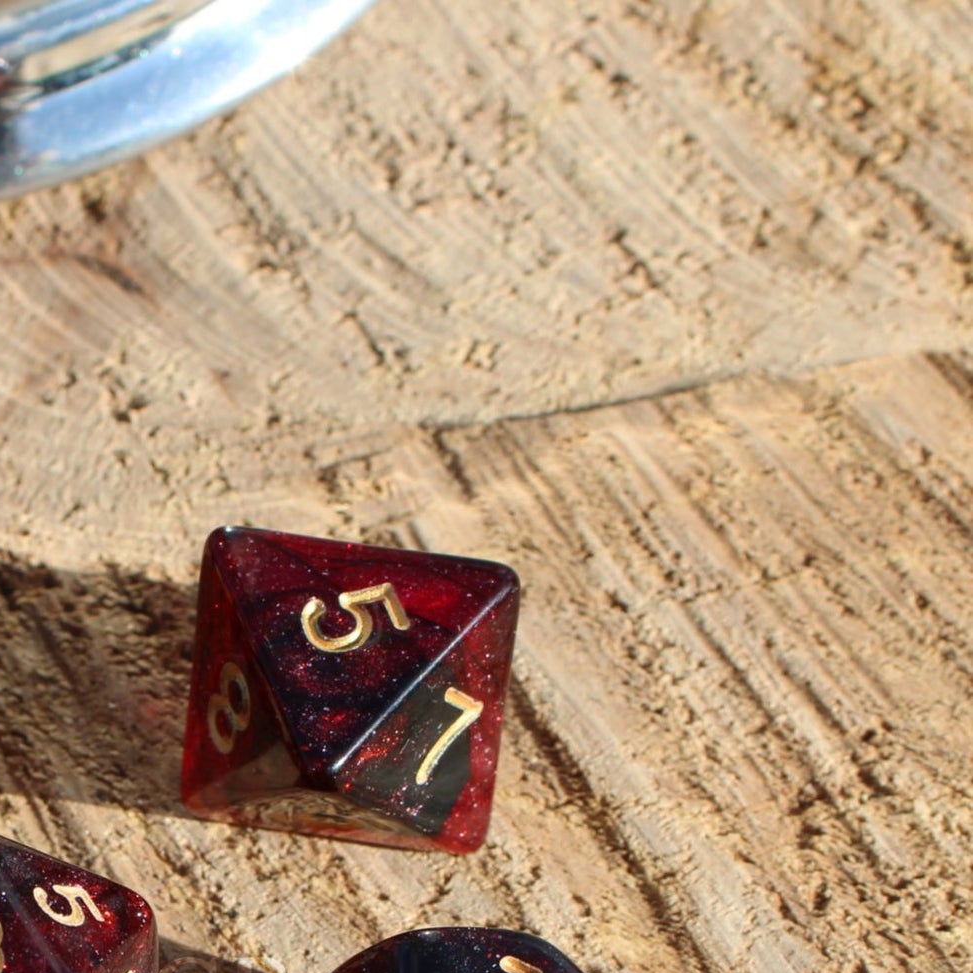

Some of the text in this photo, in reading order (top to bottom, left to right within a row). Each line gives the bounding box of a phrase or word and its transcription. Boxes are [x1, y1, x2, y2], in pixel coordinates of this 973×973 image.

[301, 582, 410, 652] 5
[208, 662, 250, 753] 8
[416, 686, 484, 785] 7
[33, 885, 105, 926] 5
